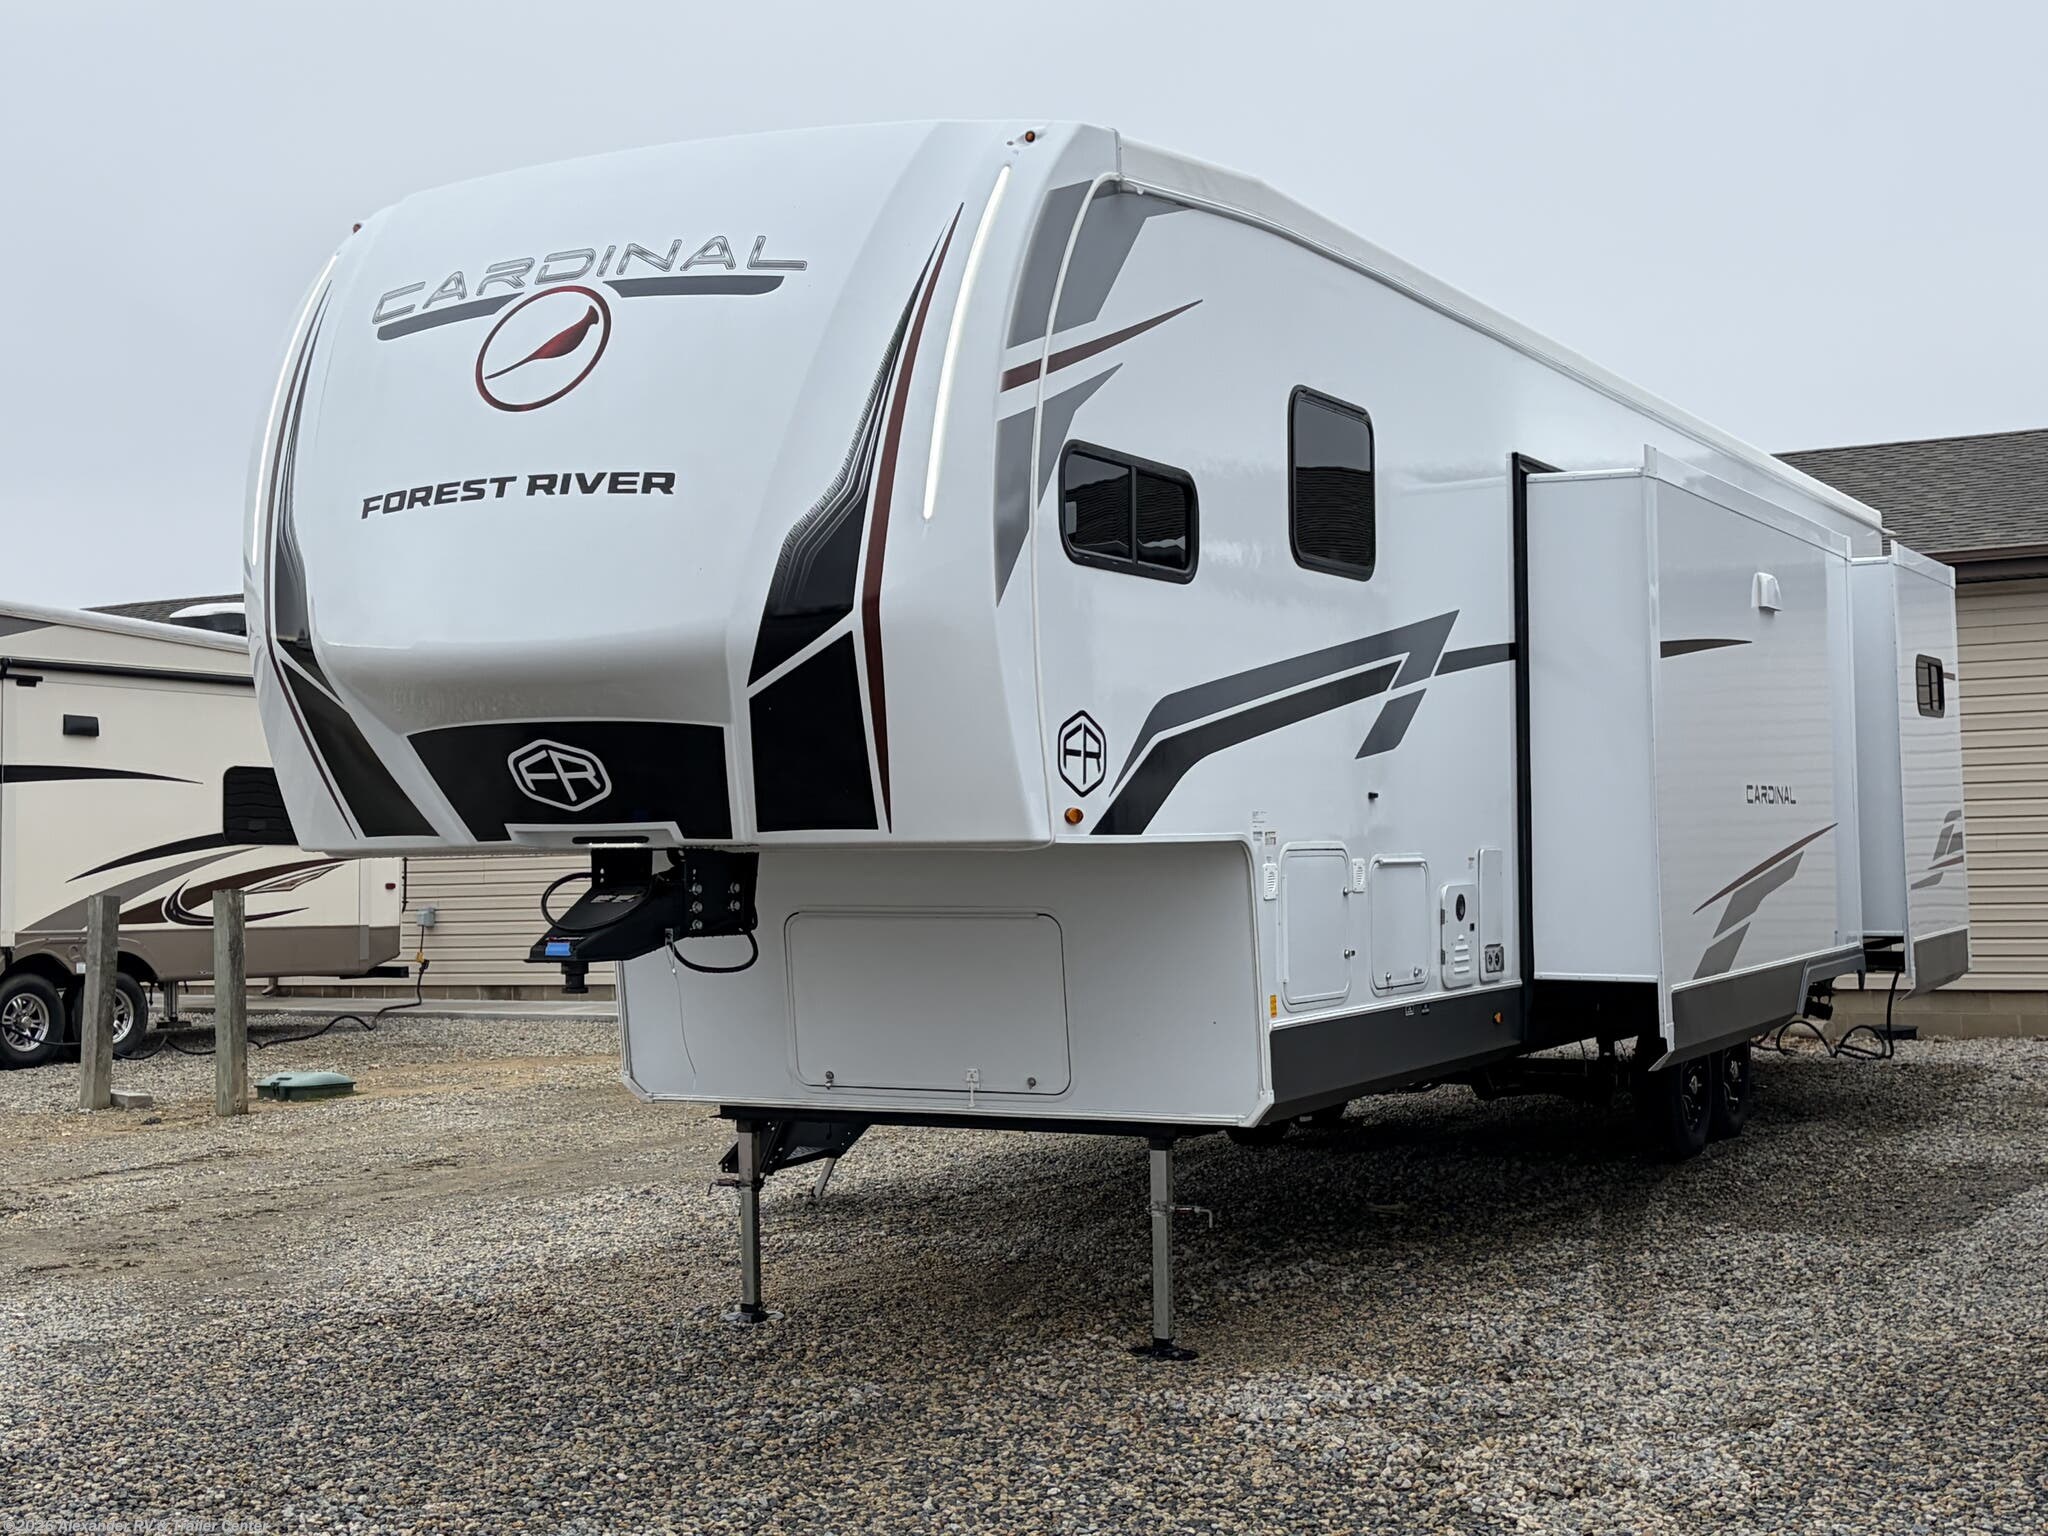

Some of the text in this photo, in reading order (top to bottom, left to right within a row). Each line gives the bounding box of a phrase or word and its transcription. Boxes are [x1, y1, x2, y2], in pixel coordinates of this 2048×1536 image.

[372, 235, 808, 325] CARDINAL
[361, 471, 676, 519] FOREST RIVER
[1746, 784, 1797, 805] CARDINAL
